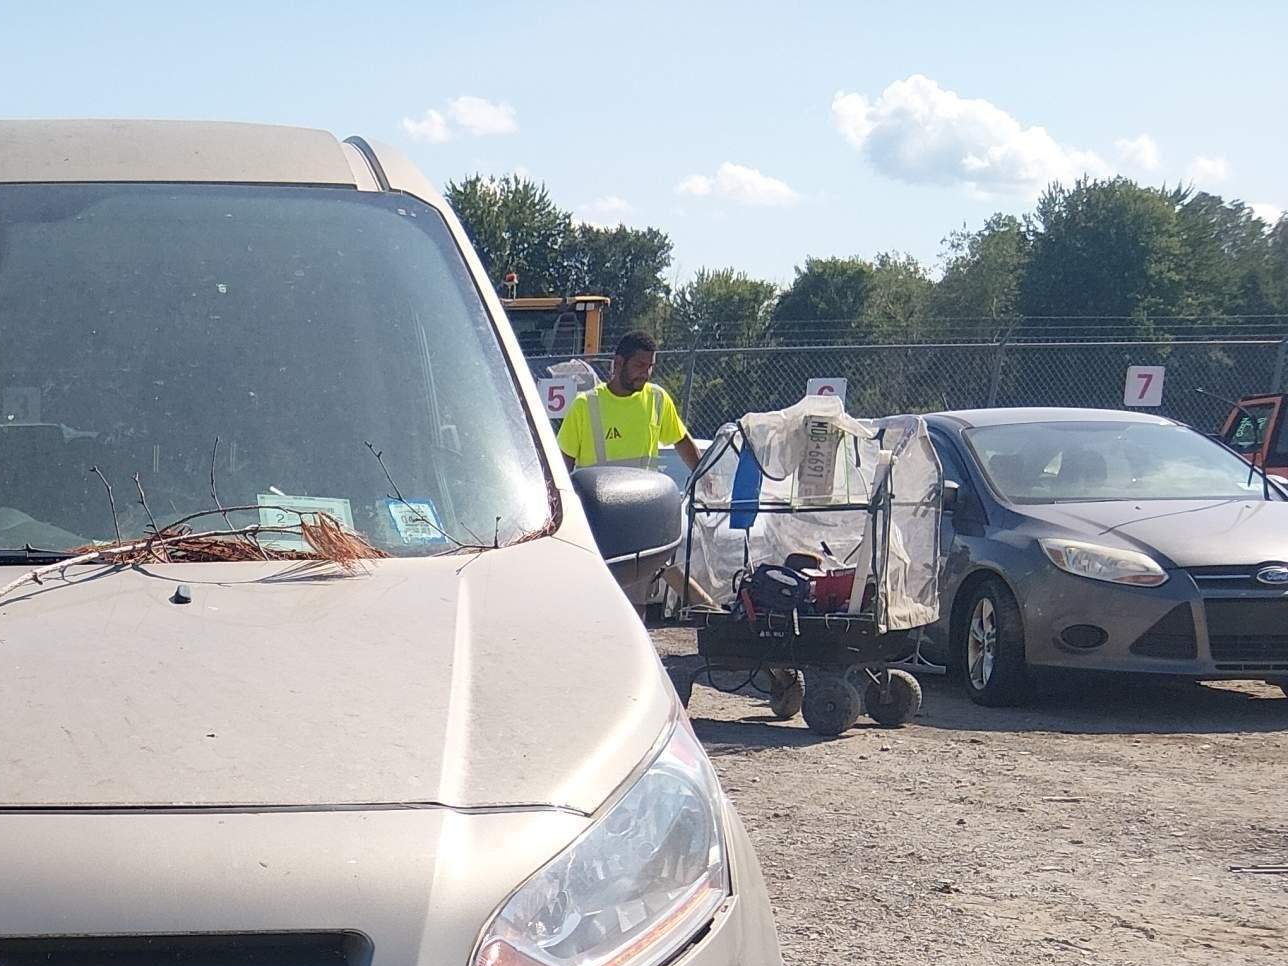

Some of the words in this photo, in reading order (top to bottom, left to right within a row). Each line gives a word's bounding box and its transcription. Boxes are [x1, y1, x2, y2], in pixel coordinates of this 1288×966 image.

[547, 384, 566, 412] 5
[1136, 373, 1153, 400] 7
[807, 449, 825, 479] 6691
